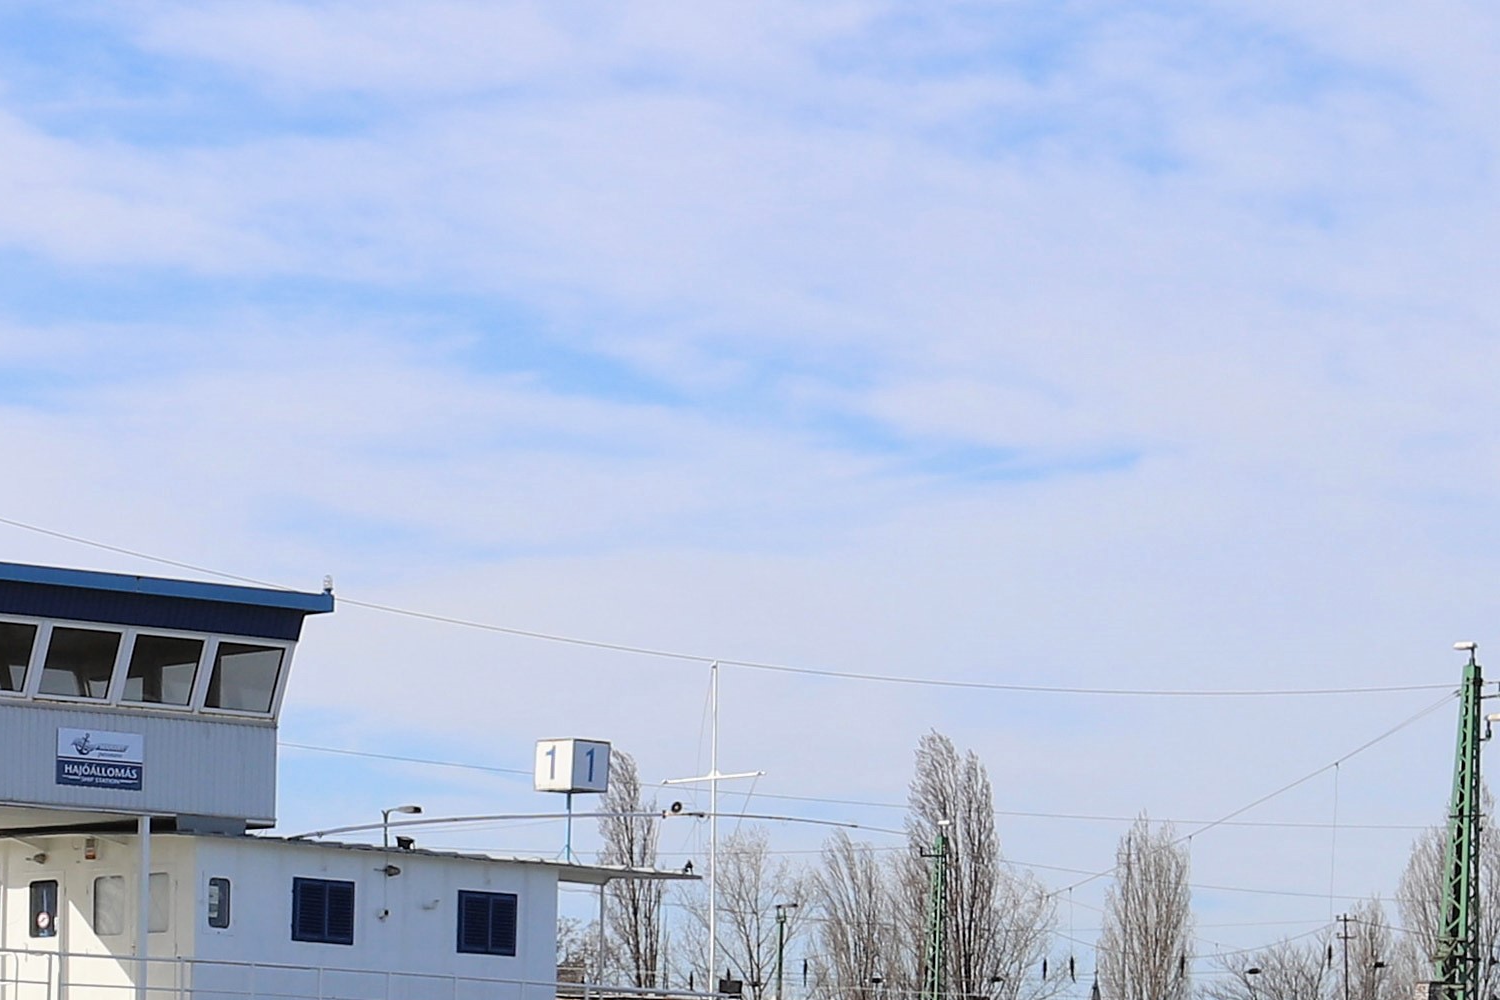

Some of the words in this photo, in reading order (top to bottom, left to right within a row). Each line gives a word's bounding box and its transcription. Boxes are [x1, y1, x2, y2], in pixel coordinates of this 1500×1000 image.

[64, 763, 138, 779] HAJÓÁLLOMÁS
[546, 745, 556, 780] 1
[586, 748, 594, 782] 1
